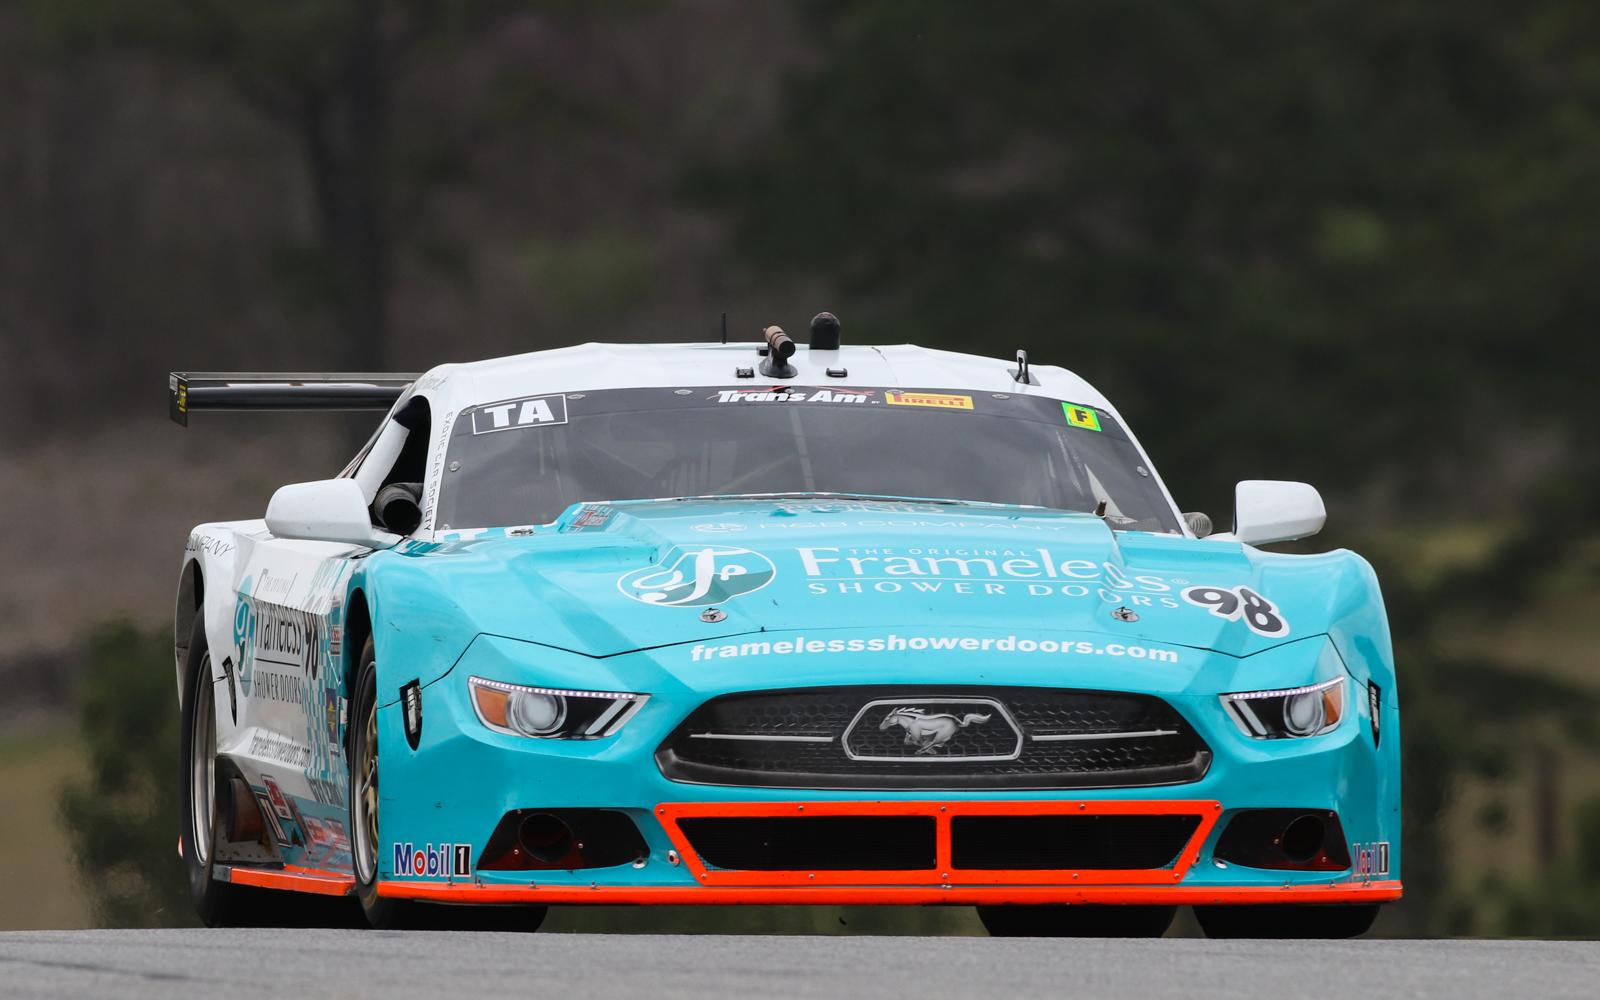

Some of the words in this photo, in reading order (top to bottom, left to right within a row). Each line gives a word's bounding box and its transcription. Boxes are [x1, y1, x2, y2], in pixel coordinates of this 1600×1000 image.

[717, 390, 806, 404] Trans
[808, 390, 867, 404] Am
[892, 393, 966, 408] PIRELLI
[483, 399, 554, 428] TA
[1074, 408, 1088, 422] F
[432, 453, 443, 477] CAR
[424, 481, 437, 531] SOCIETY
[908, 547, 1033, 557] ORIGINAL
[796, 547, 1171, 593] Frameless
[807, 581, 1007, 595] SHOWER
[1027, 584, 1180, 609] DOORS
[1184, 587, 1286, 635] 98
[690, 634, 1179, 664] framelessshowerdoors.com
[253, 670, 279, 701] SHOWER
[280, 674, 302, 705] DOORS
[393, 843, 451, 876] Mobil
